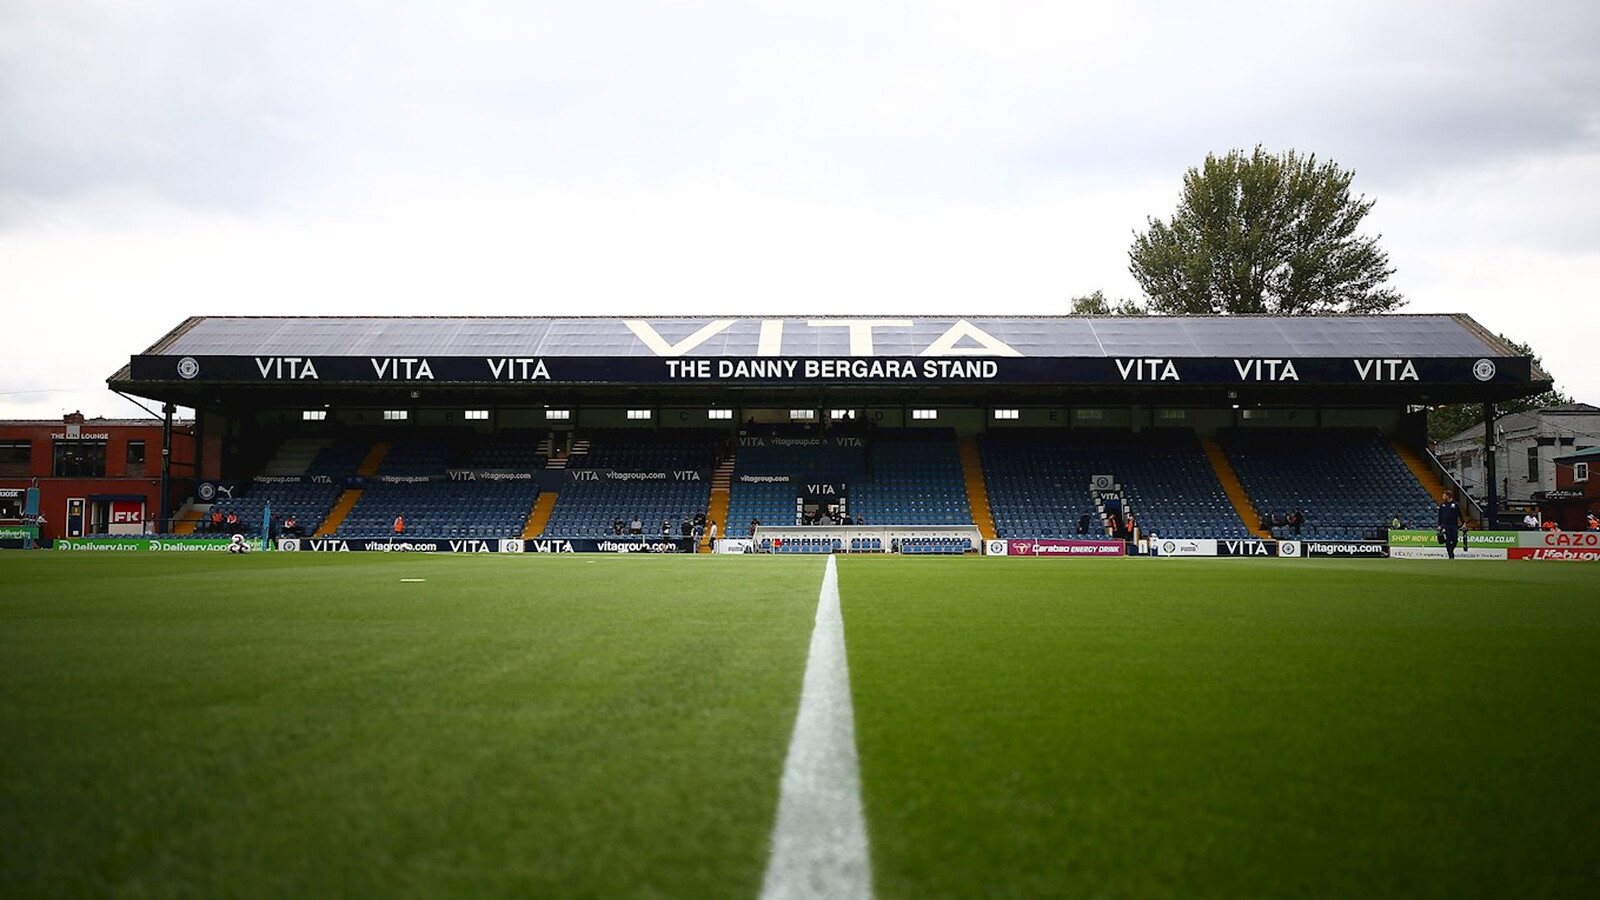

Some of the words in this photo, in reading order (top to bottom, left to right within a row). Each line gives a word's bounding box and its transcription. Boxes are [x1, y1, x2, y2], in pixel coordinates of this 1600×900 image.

[622, 319, 1026, 357] VITA
[256, 358, 318, 379] VITA
[371, 359, 434, 380] VITA
[487, 359, 550, 380] VITA
[666, 360, 711, 378] THE
[719, 360, 798, 378] DANNY
[805, 360, 917, 378] BERGARA
[923, 360, 998, 378] STAND
[1115, 359, 1179, 380] VITA
[1234, 360, 1298, 381] VITA
[1354, 360, 1419, 381] VITA
[739, 437, 765, 447] VITA
[836, 437, 862, 447] VITA
[253, 475, 300, 484] vitagroup.com
[311, 475, 332, 484] VITA
[381, 475, 429, 484] vitagroup.com
[450, 471, 476, 481] VITA
[480, 472, 531, 481] vitagroup.com
[572, 471, 599, 481] VITA
[606, 471, 666, 481] vitagroup.com
[673, 471, 700, 481] VITA
[740, 475, 789, 484] vitagroup.com
[807, 484, 835, 495] VITA
[115, 511, 139, 522] FK
[310, 540, 350, 552] VITA
[450, 540, 490, 553] VITA
[533, 540, 574, 553] VITA
[1226, 541, 1268, 555] VITA
[1308, 543, 1382, 554] vitagroup.com
